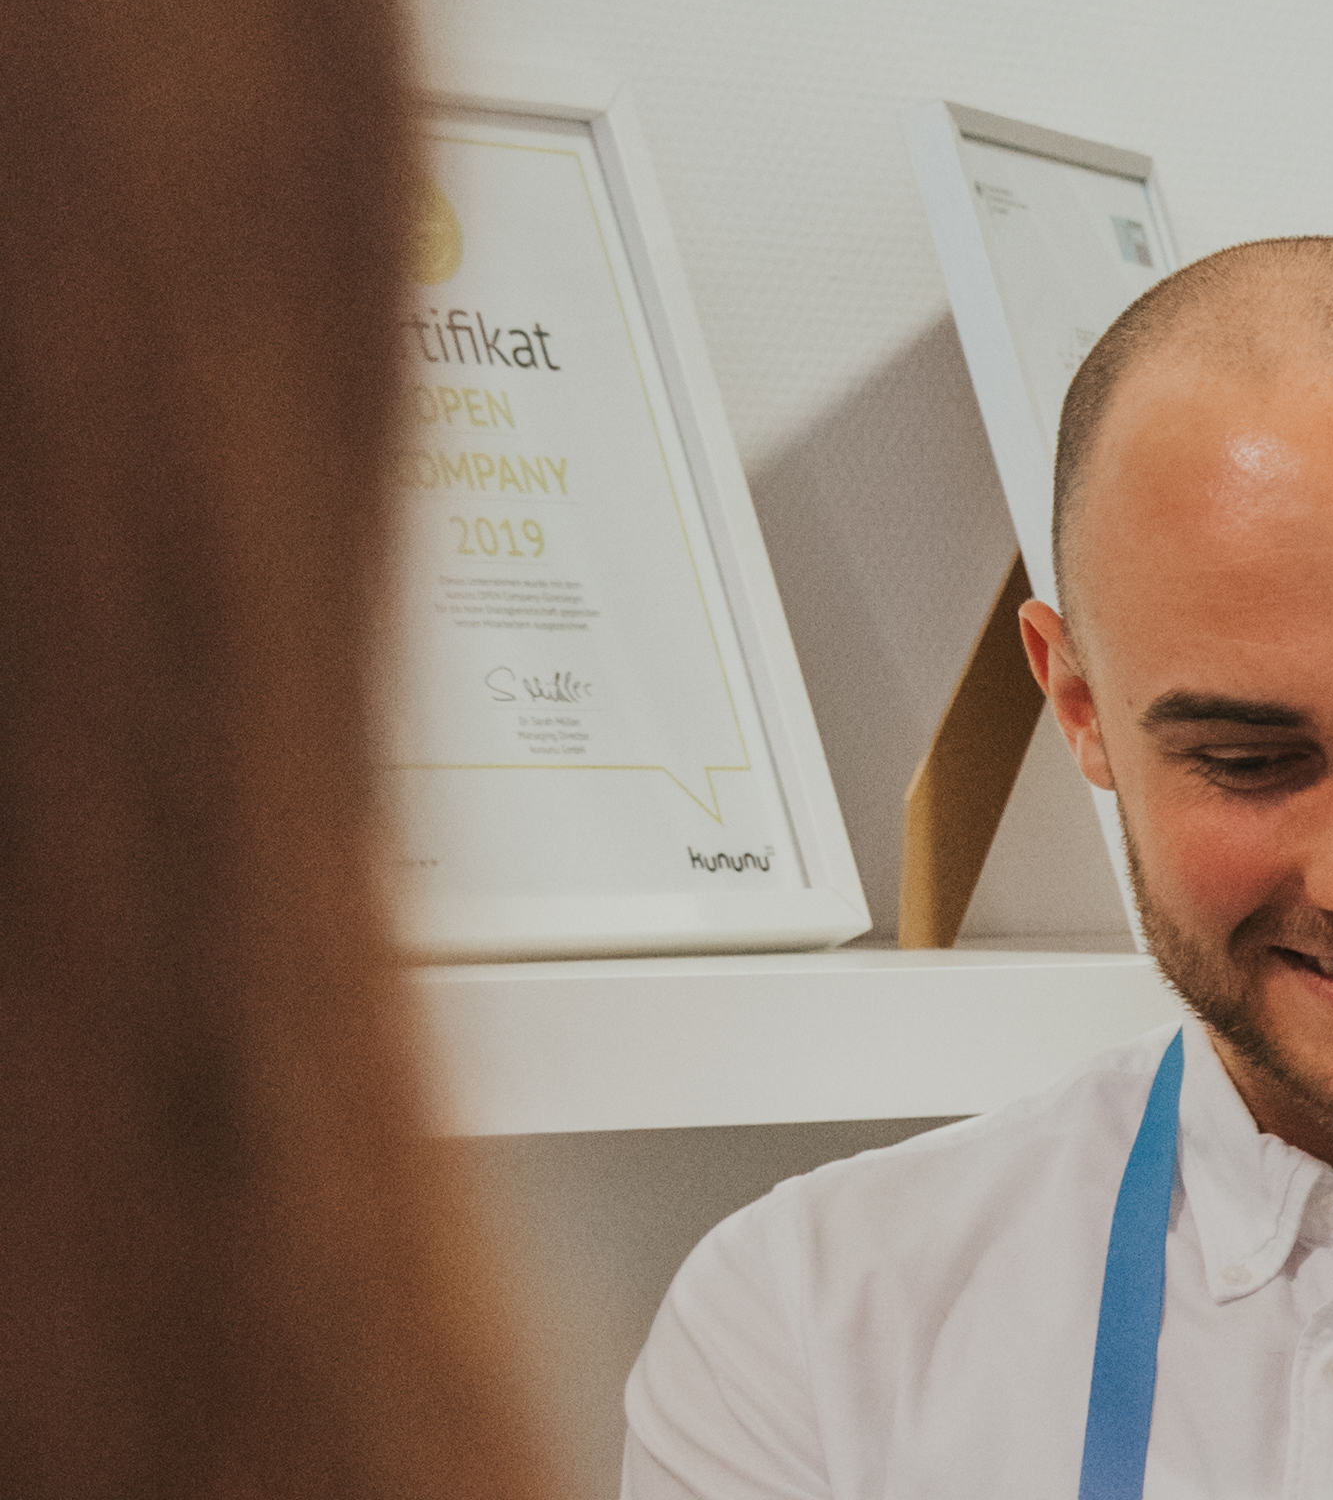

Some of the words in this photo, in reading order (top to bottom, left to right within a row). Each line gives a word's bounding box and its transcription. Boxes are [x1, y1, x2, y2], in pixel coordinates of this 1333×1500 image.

[402, 306, 562, 372] tifikat
[413, 384, 516, 430] OPEN
[449, 515, 546, 558] 2019
[687, 846, 770, 873] kununu
